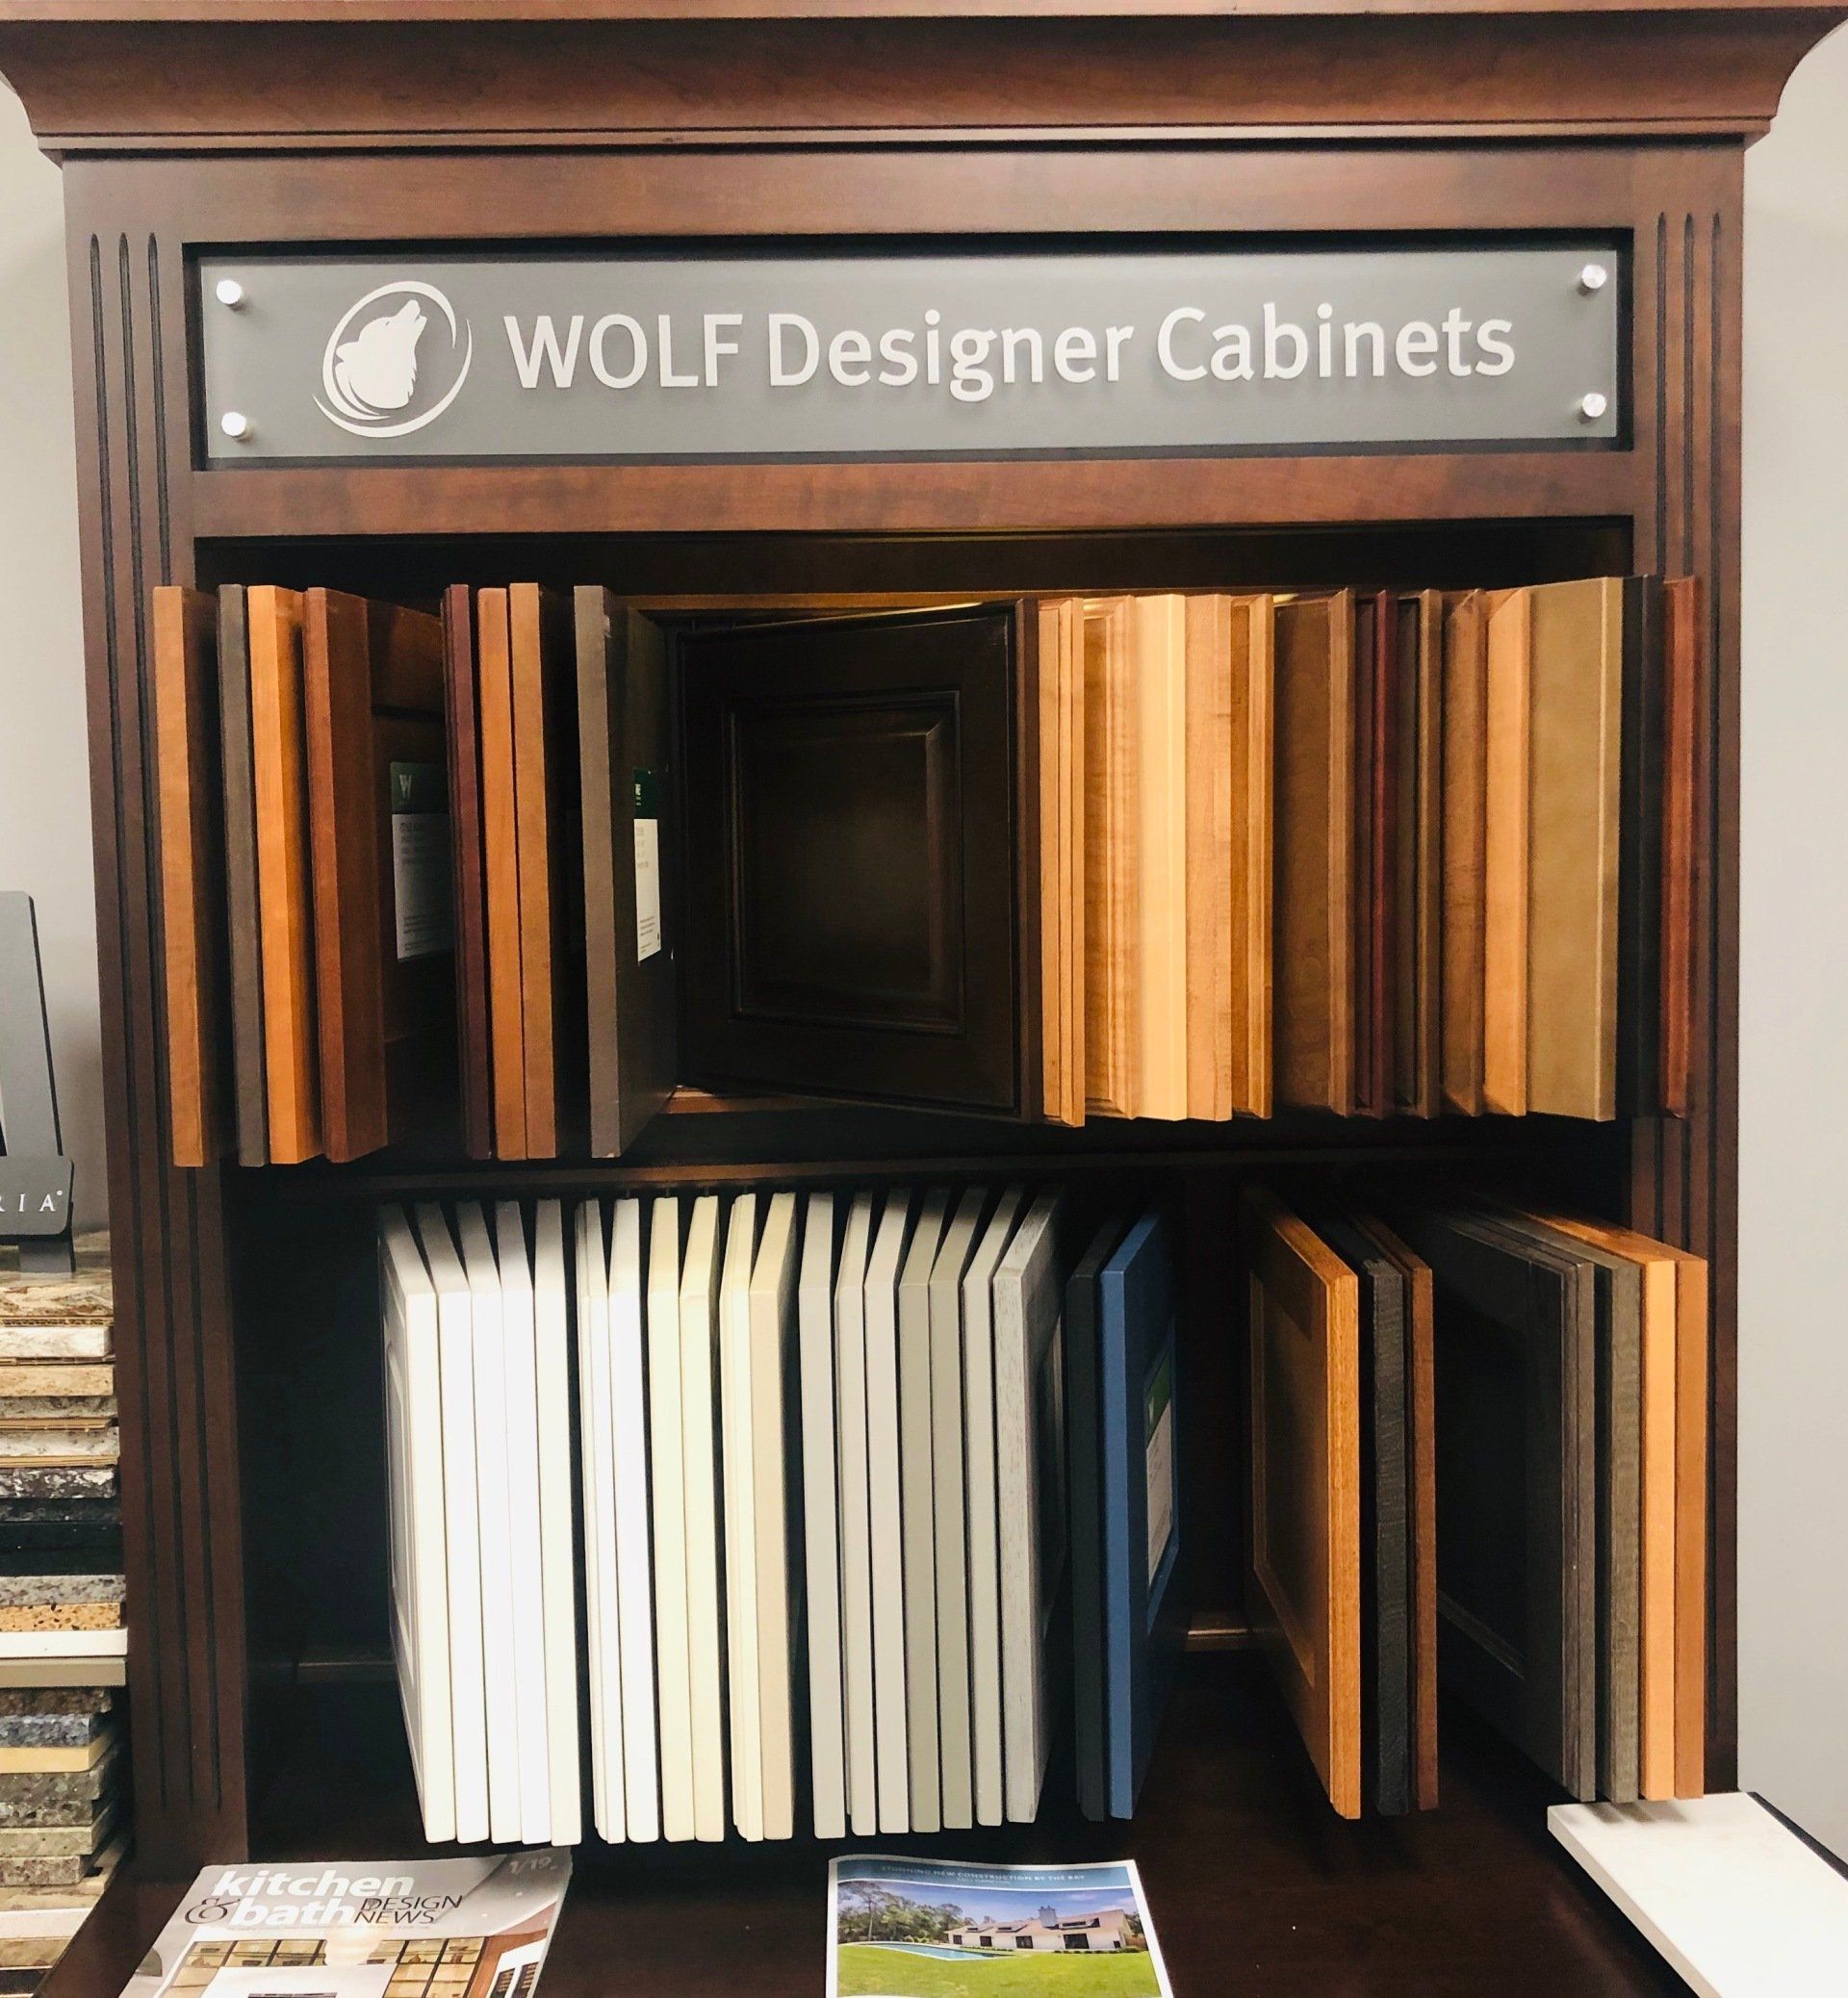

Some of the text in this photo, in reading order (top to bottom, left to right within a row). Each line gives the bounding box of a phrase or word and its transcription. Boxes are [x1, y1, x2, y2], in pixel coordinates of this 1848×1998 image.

[504, 301, 1514, 401] WOLF Designer Cabinets
[211, 1869, 415, 1897] kitchen
[958, 1872, 1033, 1882] CONSTRUCTION
[185, 1897, 355, 1925] & bath
[360, 1895, 463, 1911] DESIGN
[353, 1910, 435, 1924] NEWS
